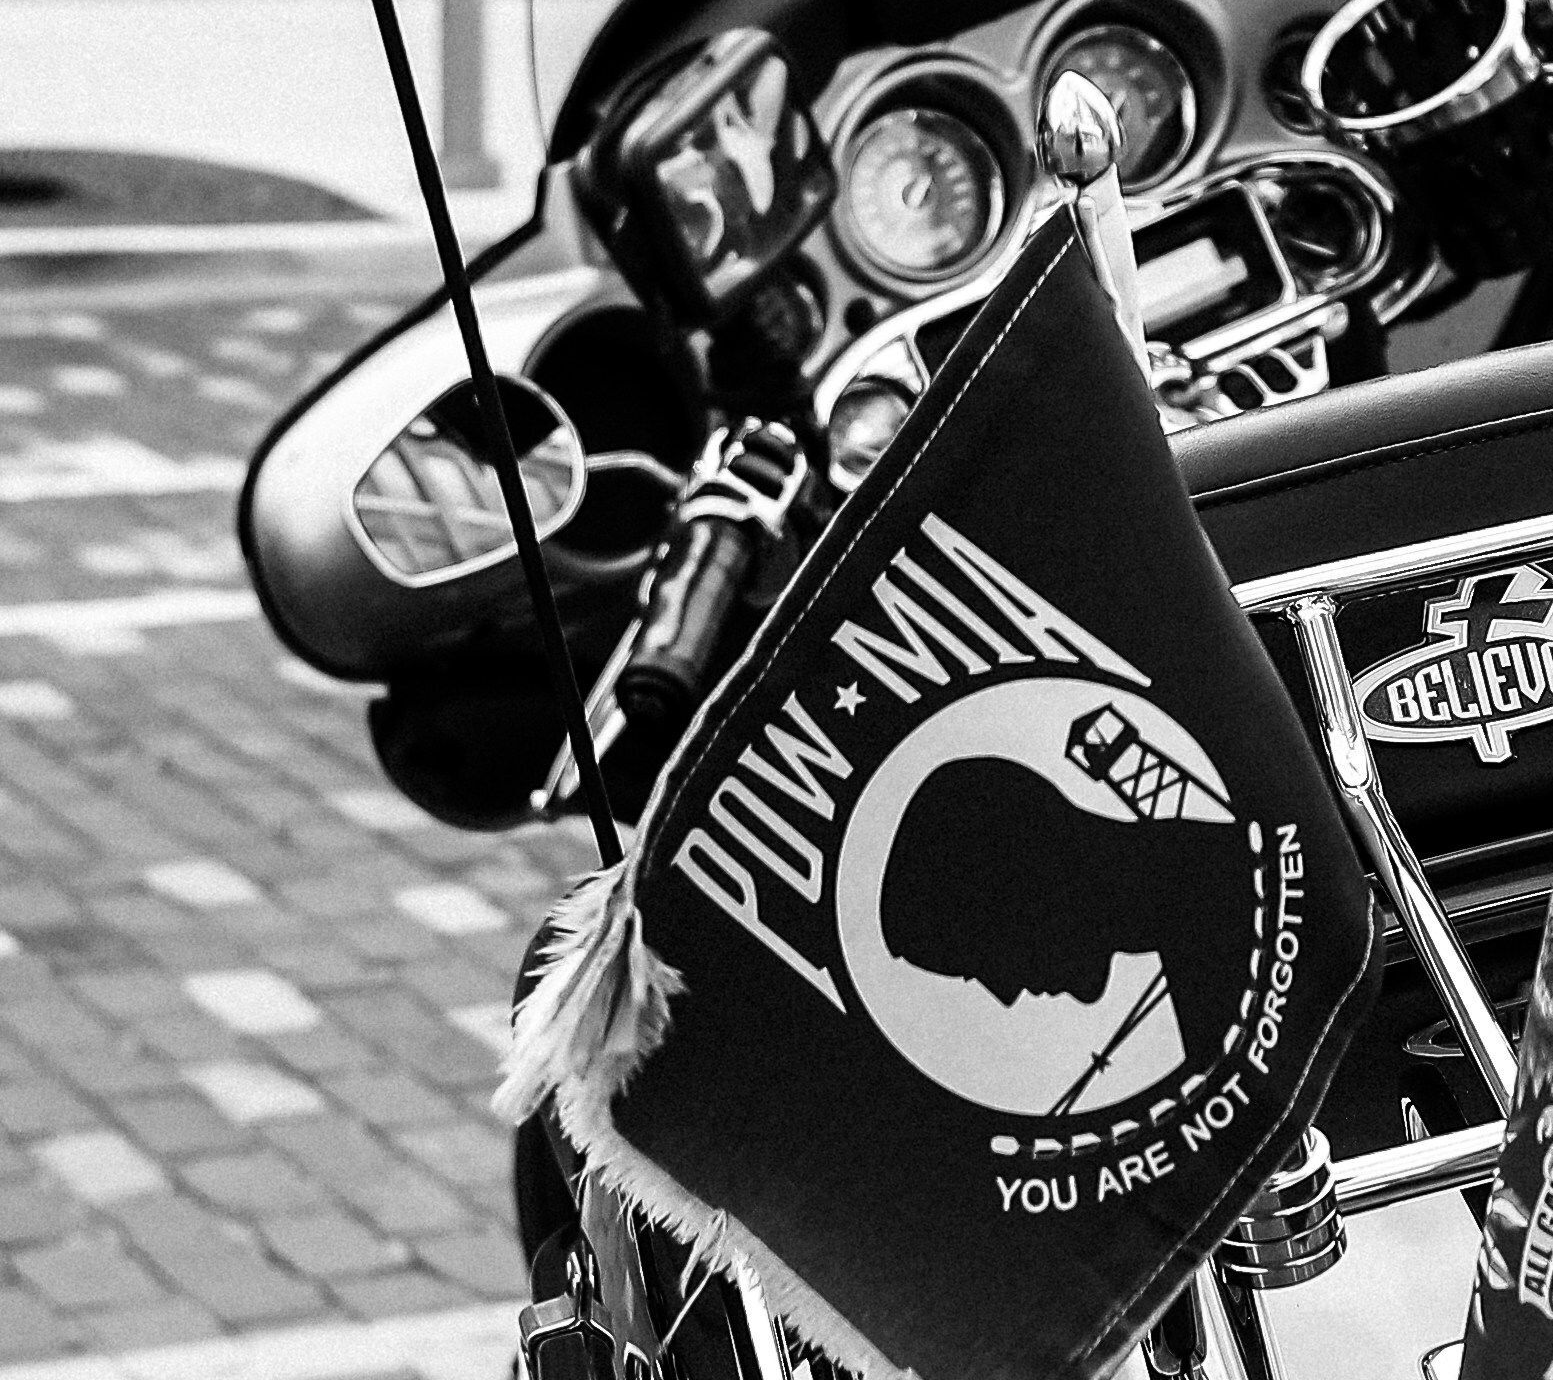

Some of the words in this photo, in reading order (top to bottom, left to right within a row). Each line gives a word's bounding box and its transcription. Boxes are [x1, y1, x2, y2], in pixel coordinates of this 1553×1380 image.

[672, 687, 860, 1015] POW
[830, 511, 1152, 704] MIA
[995, 1174, 1079, 1215] YOU
[1097, 1140, 1176, 1203] ARE
[1178, 1071, 1251, 1153] NOT
[1247, 821, 1304, 1075] FORGOTTEN
[1523, 1243, 1553, 1298] ALL
